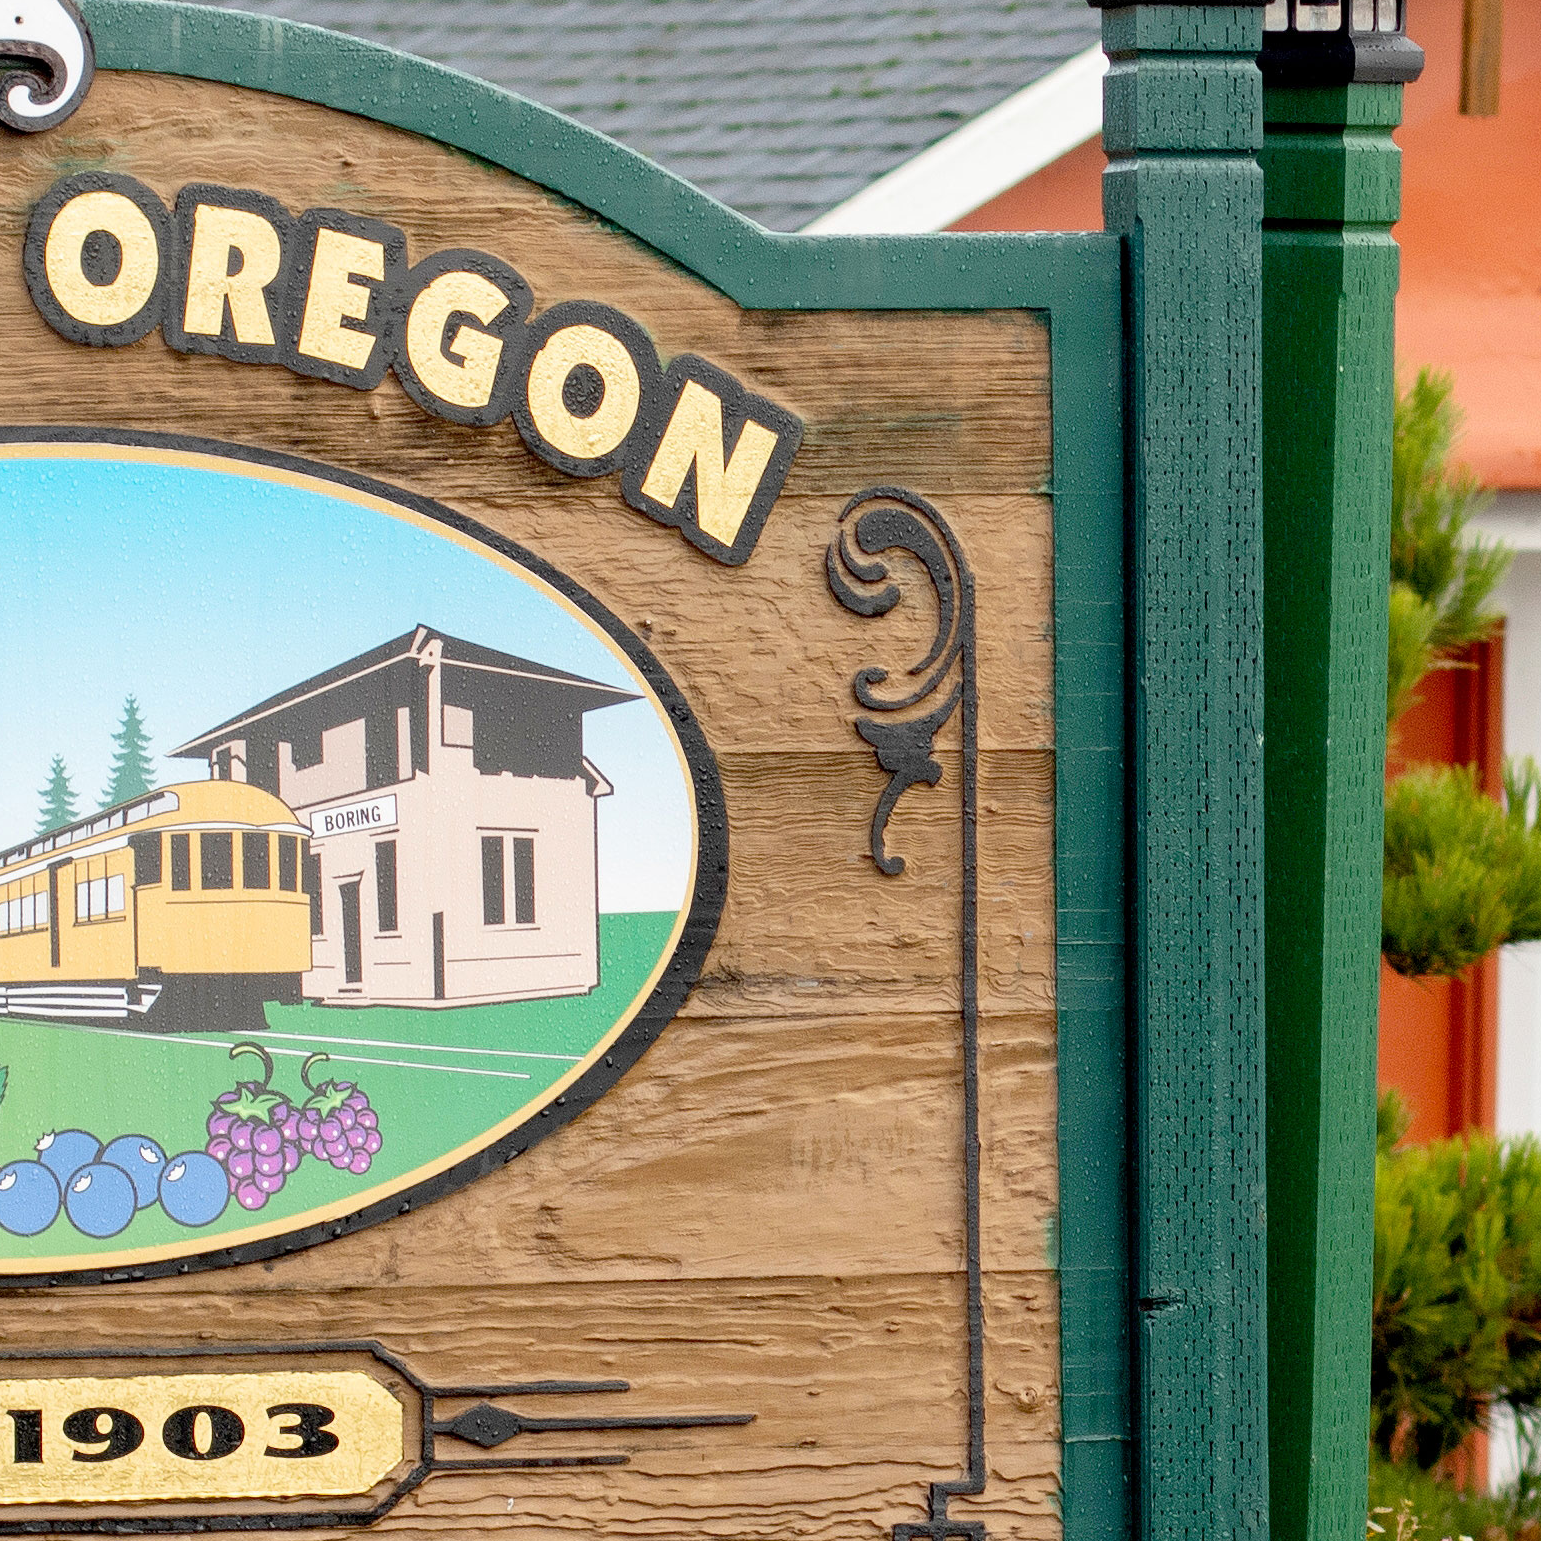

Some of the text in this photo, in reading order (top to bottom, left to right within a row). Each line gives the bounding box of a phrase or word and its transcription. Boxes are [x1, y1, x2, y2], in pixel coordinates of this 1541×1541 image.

[43, 189, 781, 538] OREGON
[324, 803, 382, 831] BORING
[4, 1401, 341, 1466] 1903
